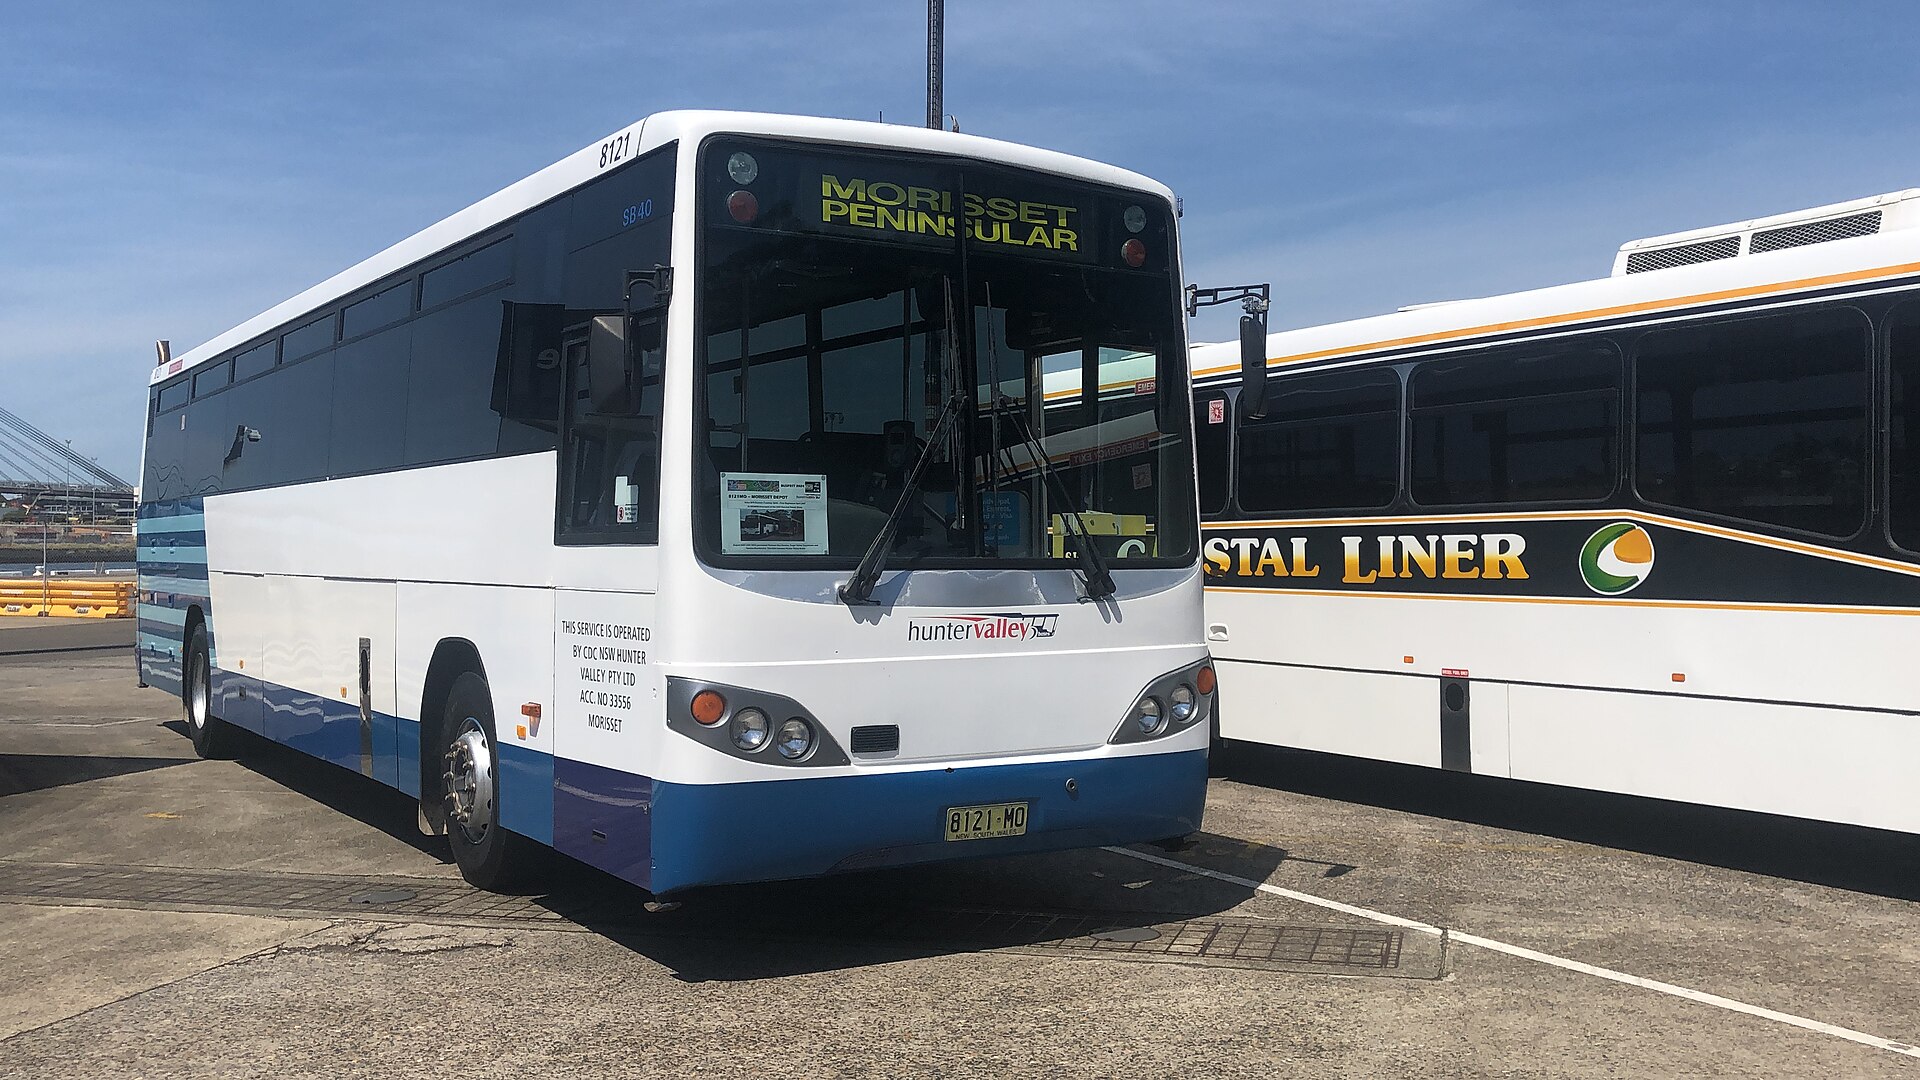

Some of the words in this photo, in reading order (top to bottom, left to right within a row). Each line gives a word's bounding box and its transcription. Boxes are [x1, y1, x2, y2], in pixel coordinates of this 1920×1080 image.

[599, 131, 631, 169] 8121
[821, 174, 1078, 228] MORISSET
[821, 199, 1079, 252] PENINSULAR
[1340, 533, 1531, 584] LINER
[561, 620, 576, 635] THIS
[577, 621, 604, 637] SERVICE
[605, 623, 612, 638] IS
[613, 624, 651, 642] OPERATED
[572, 644, 582, 658] BY
[583, 646, 598, 661] CDC
[600, 646, 616, 661] NSW
[617, 648, 647, 665] HUNTER
[580, 666, 606, 683] VALLEY
[608, 670, 622, 685] PTY
[622, 671, 636, 687] LTD
[579, 689, 596, 704] ACC.
[597, 691, 608, 706] NO
[609, 693, 632, 710] 33556
[588, 713, 623, 733] MORISSET
[950, 809, 992, 833] 8121
[1003, 806, 1026, 829] MO
[955, 832, 970, 840] NEW
[973, 831, 995, 839] SOUTH
[996, 828, 1018, 837] WALES
